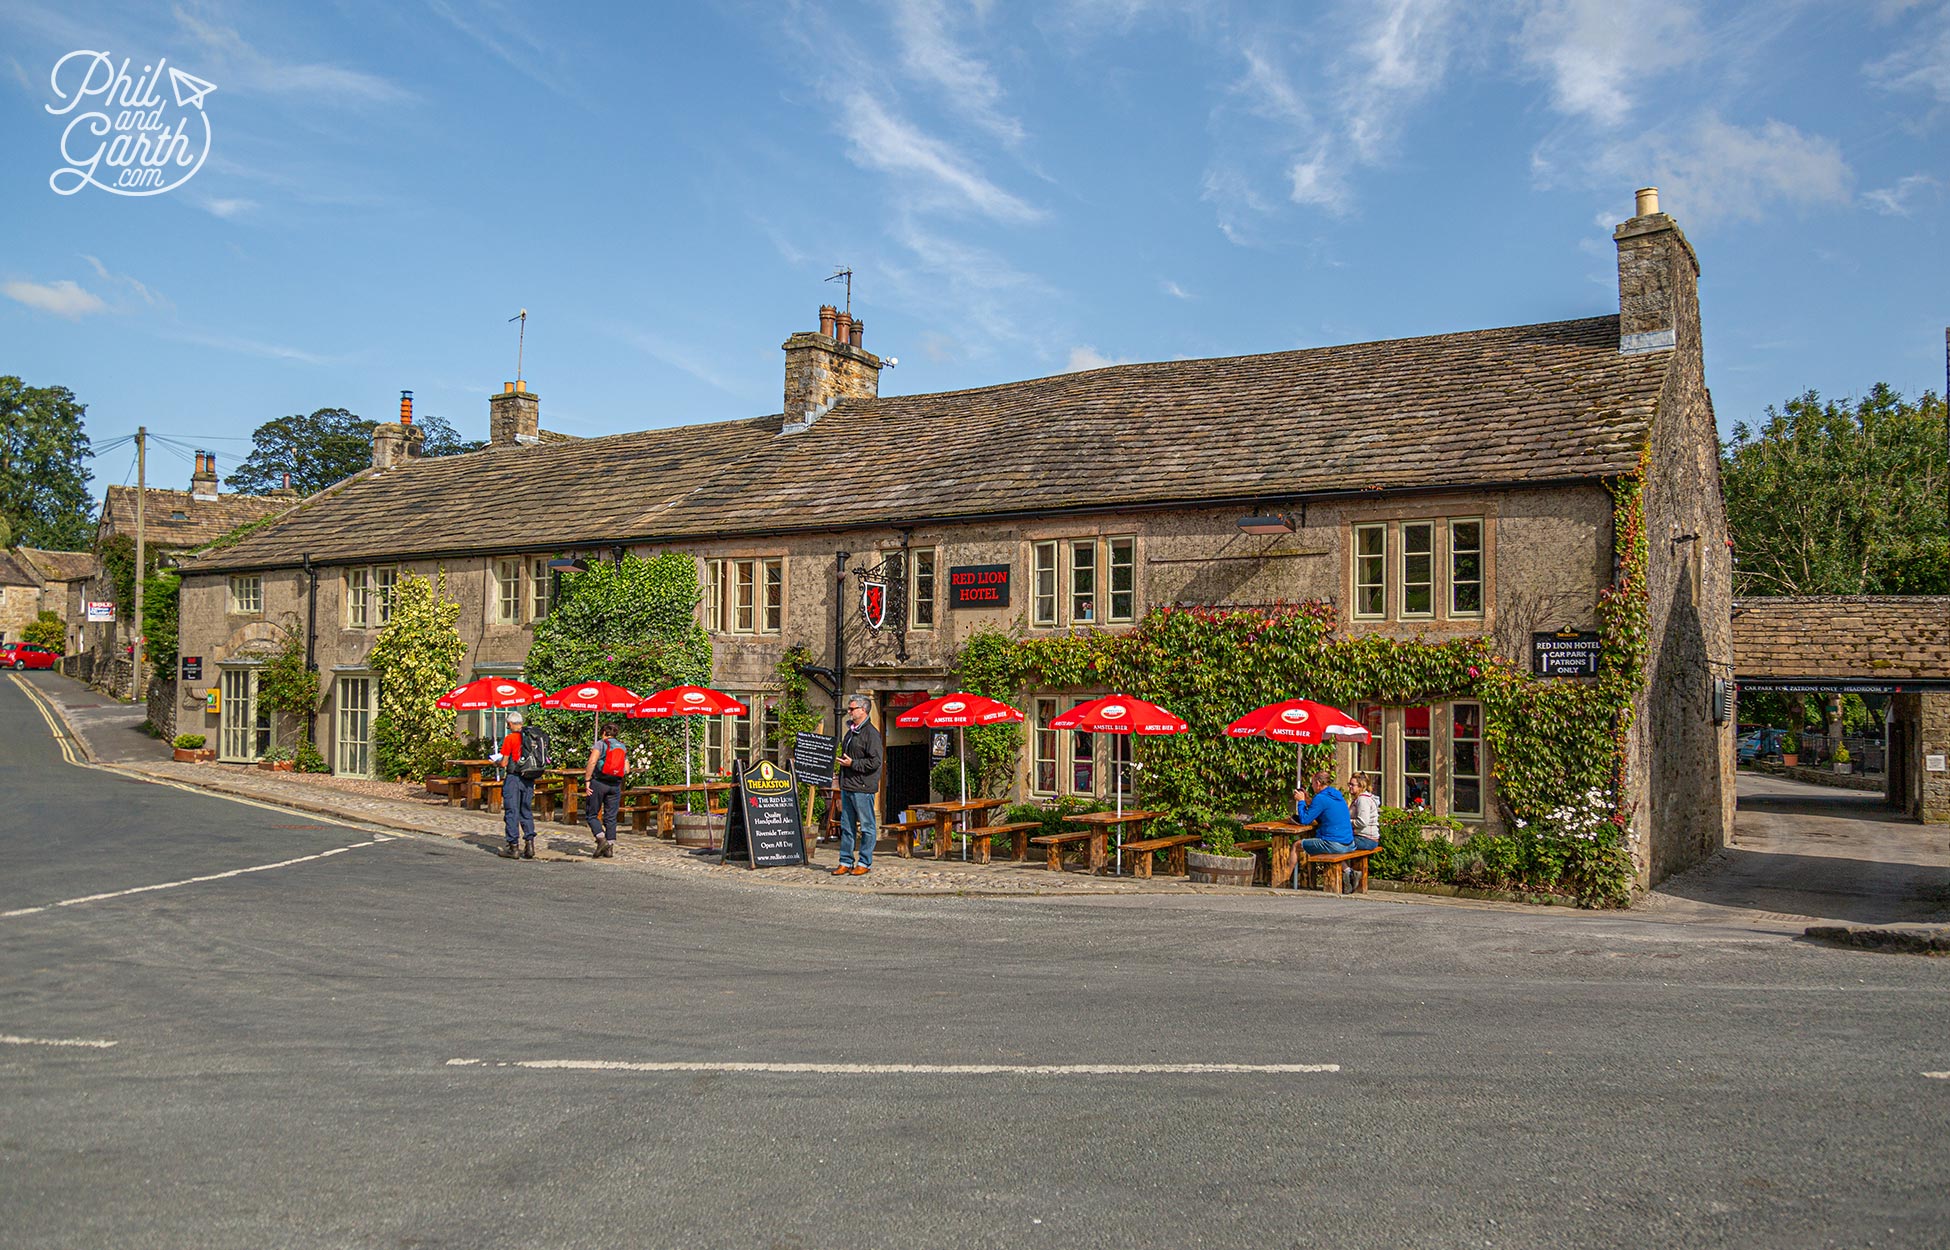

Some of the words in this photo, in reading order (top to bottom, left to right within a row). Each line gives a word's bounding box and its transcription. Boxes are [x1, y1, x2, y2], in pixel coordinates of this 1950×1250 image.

[952, 573, 976, 585] RED
[978, 571, 1008, 585] LION
[960, 587, 999, 600] HOTEL
[1536, 642, 1552, 650] RED
[1553, 642, 1573, 650] LION
[1574, 641, 1601, 649] HOTEL
[1272, 728, 1294, 736] AMSTEL
[1295, 729, 1311, 737] BIER
[747, 779, 790, 789] THEAKSTON
[760, 842, 775, 850] Open
